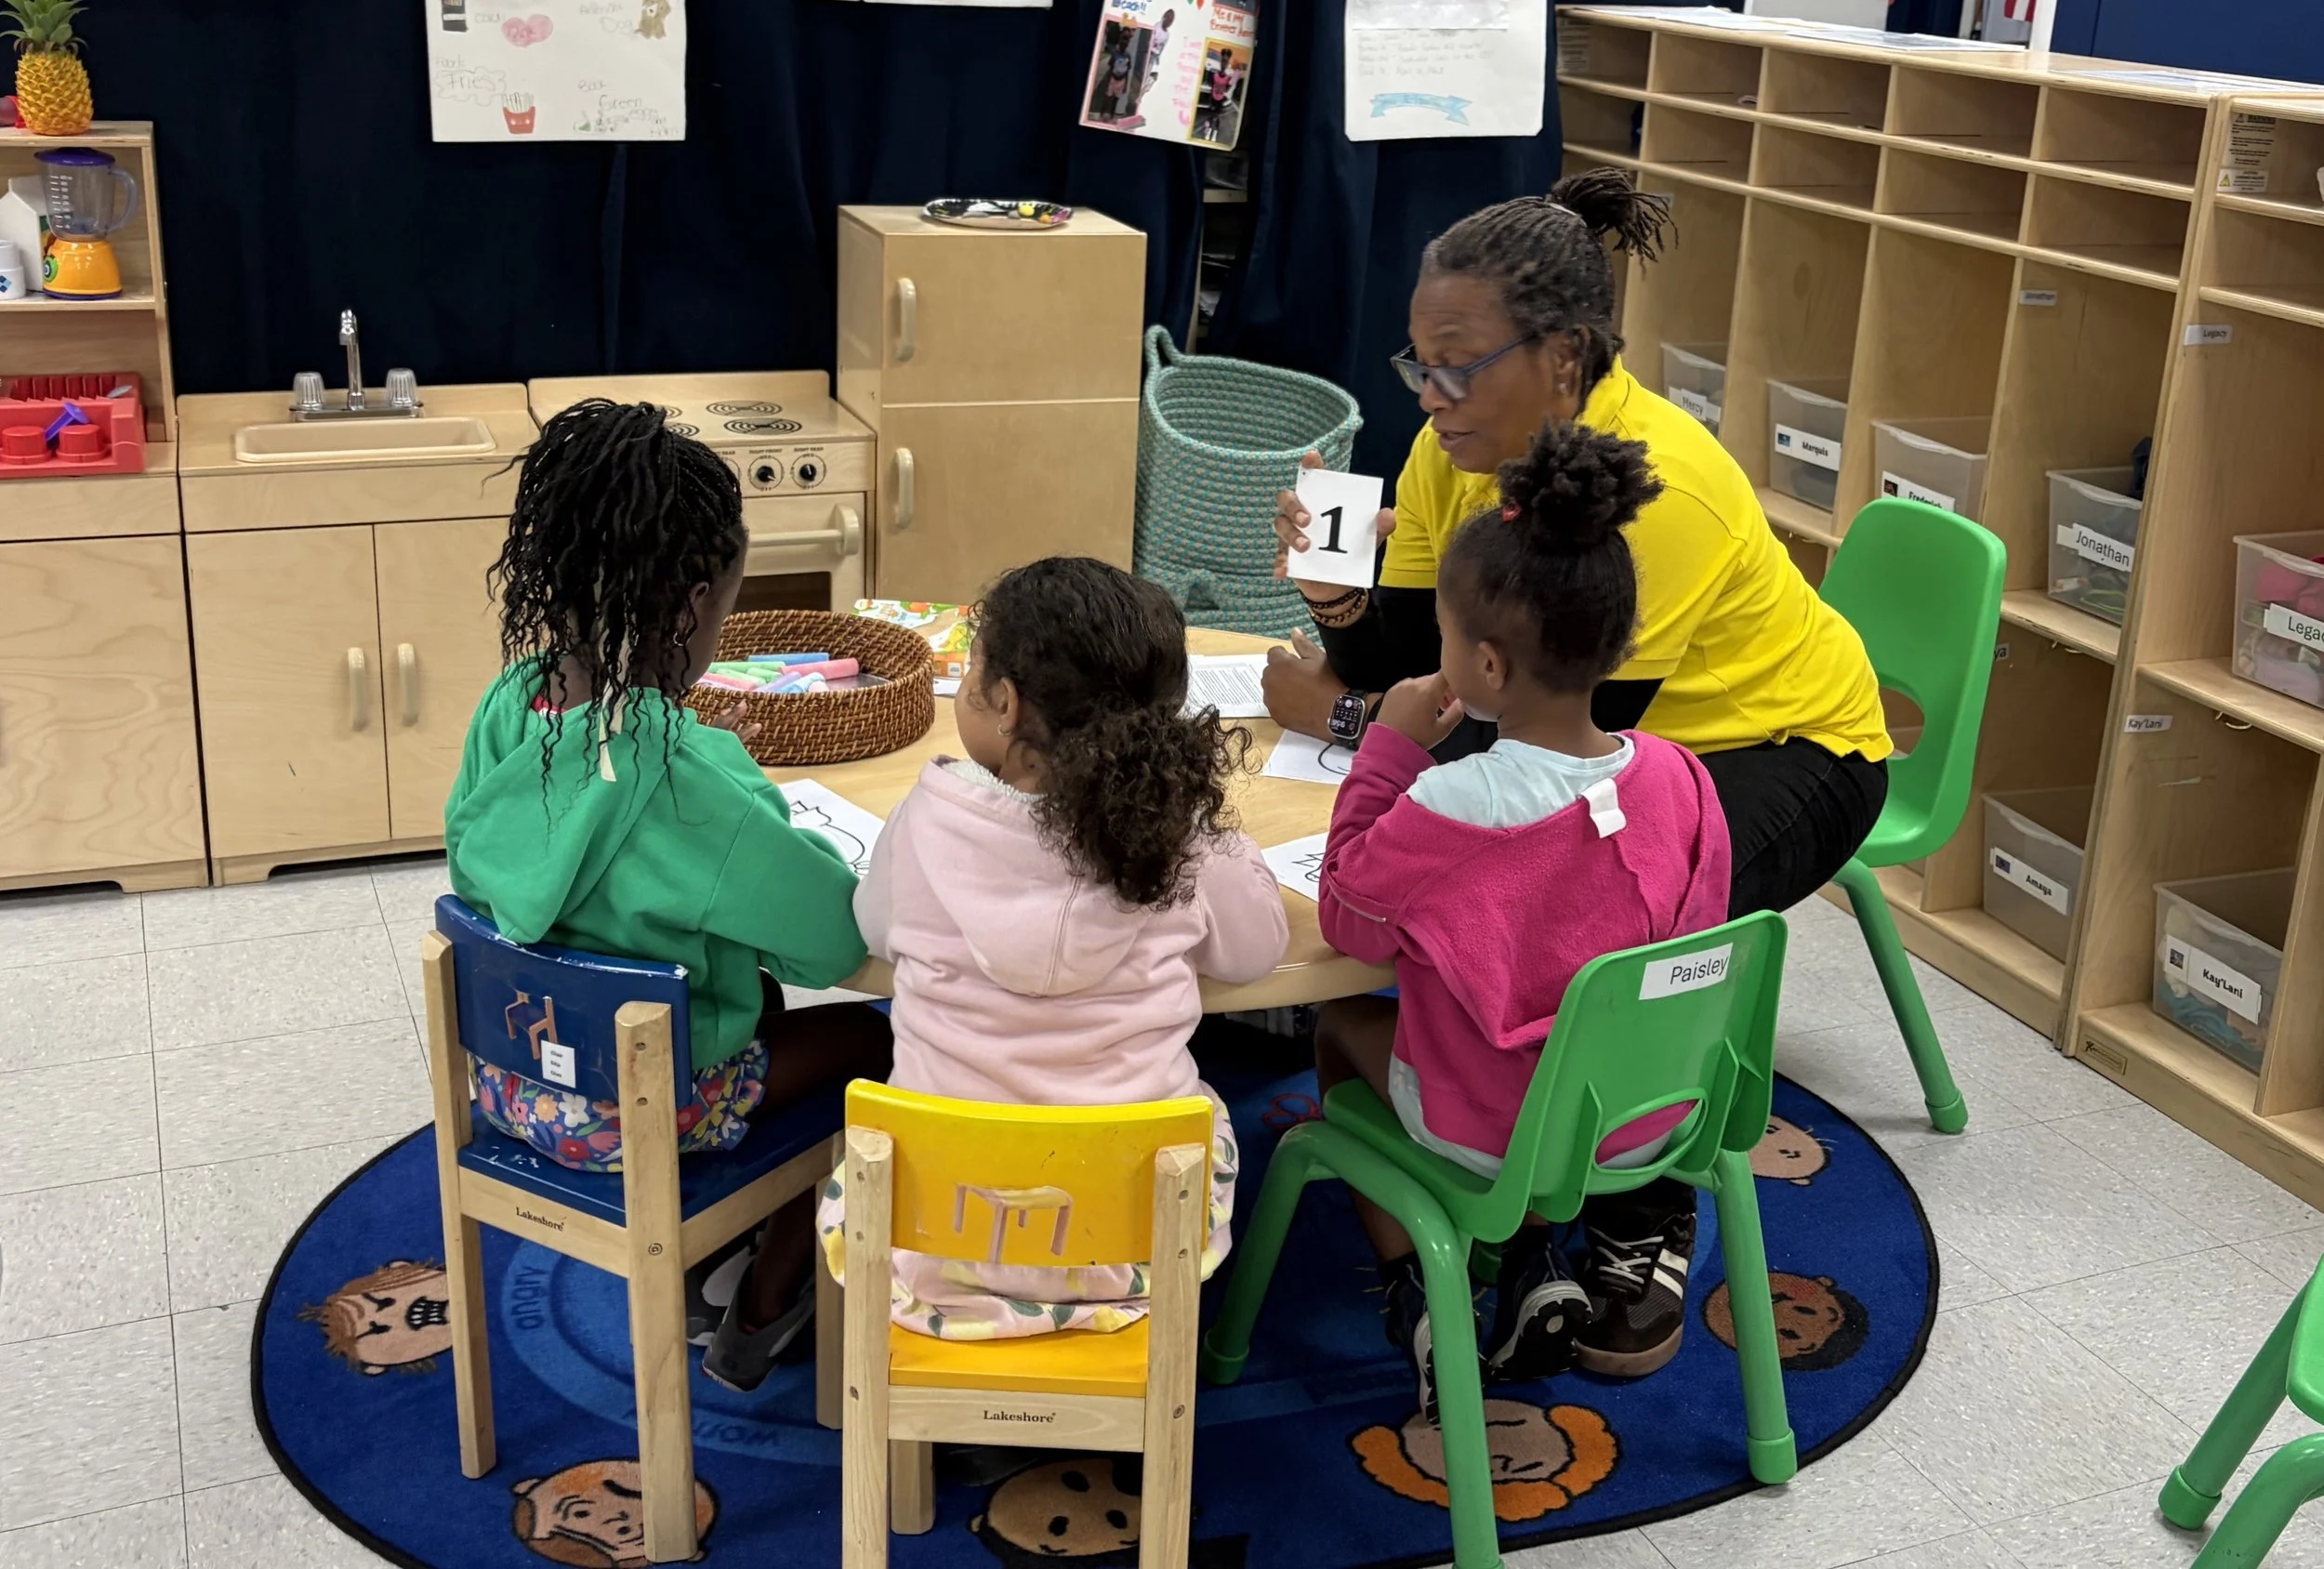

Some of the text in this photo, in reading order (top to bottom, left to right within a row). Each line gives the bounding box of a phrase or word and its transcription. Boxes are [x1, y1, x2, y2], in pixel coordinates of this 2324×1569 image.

[599, 94, 641, 112] Green
[1802, 441, 1829, 456] Marquis
[1318, 506, 1348, 554] 1
[2076, 531, 2130, 566] Jonathan
[2026, 875, 2052, 896] Amaya
[1670, 957, 1729, 985] Paisley
[2202, 969, 2243, 998] Kay'Lani
[516, 1206, 564, 1233] Lakeshore
[511, 1265, 549, 1330] angry
[983, 1409, 1055, 1423] Lakeshore
